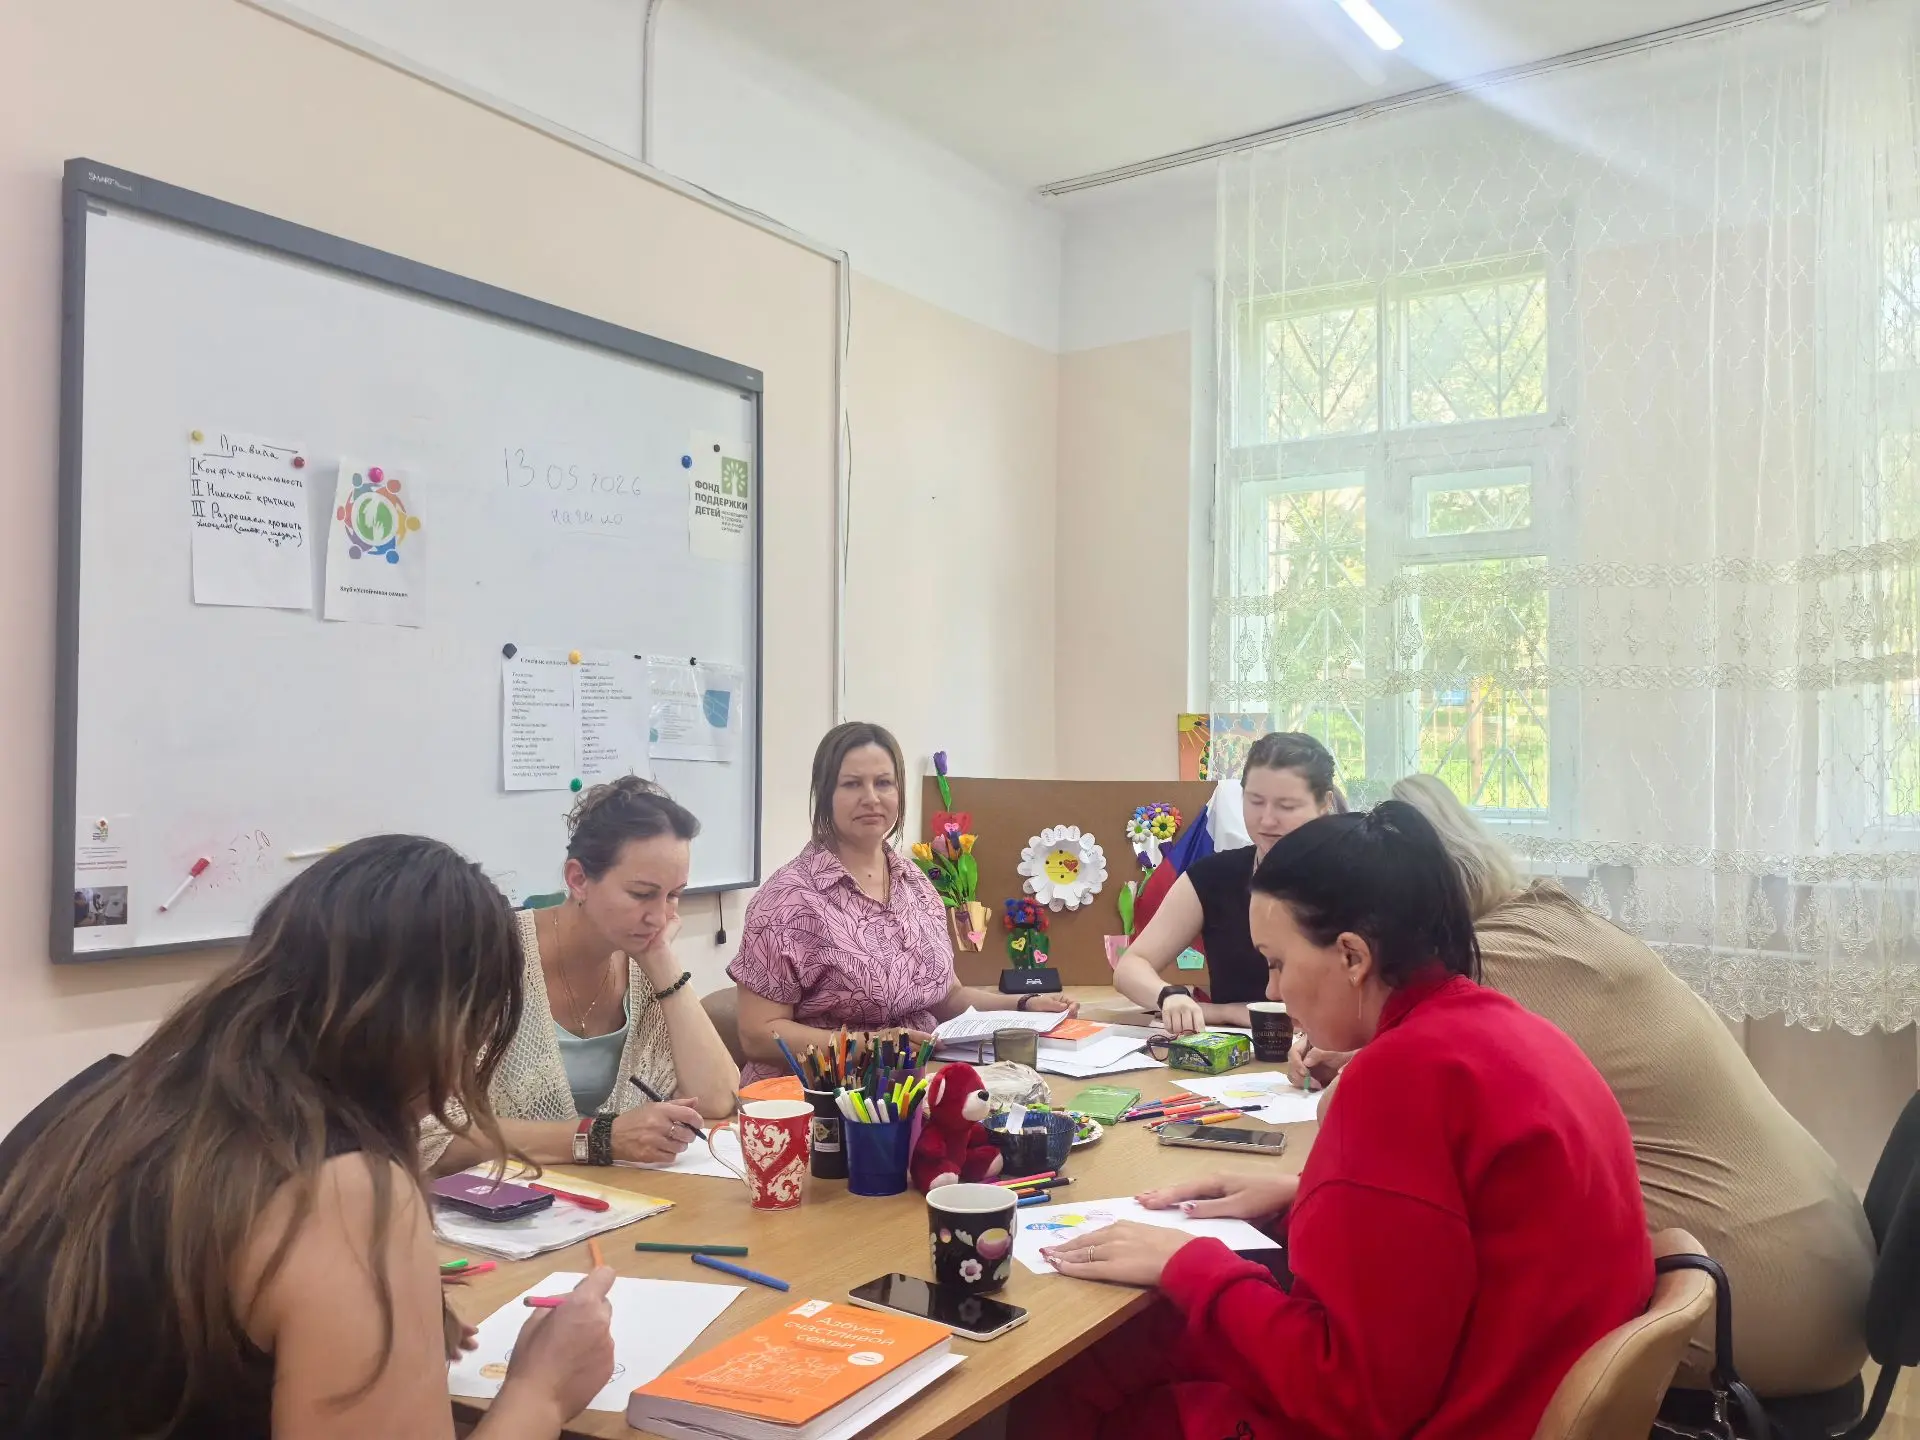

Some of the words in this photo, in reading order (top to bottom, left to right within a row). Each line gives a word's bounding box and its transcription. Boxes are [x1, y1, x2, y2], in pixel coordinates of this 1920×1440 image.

[220, 433, 279, 459] Правила
[503, 447, 535, 488] 13
[546, 464, 579, 491] 05
[590, 472, 642, 497] 2026
[206, 481, 253, 501] Никакой
[257, 495, 296, 509] критики
[694, 480, 720, 494] ФОНД
[694, 492, 748, 511] ПОДДЕРЖКИ
[694, 505, 721, 518] ДЕТЕЙ
[211, 501, 266, 523] Разрешаем
[783, 1321, 896, 1346] счастливой
[815, 1317, 885, 1335] Азбука
[796, 1333, 857, 1349] семьи
